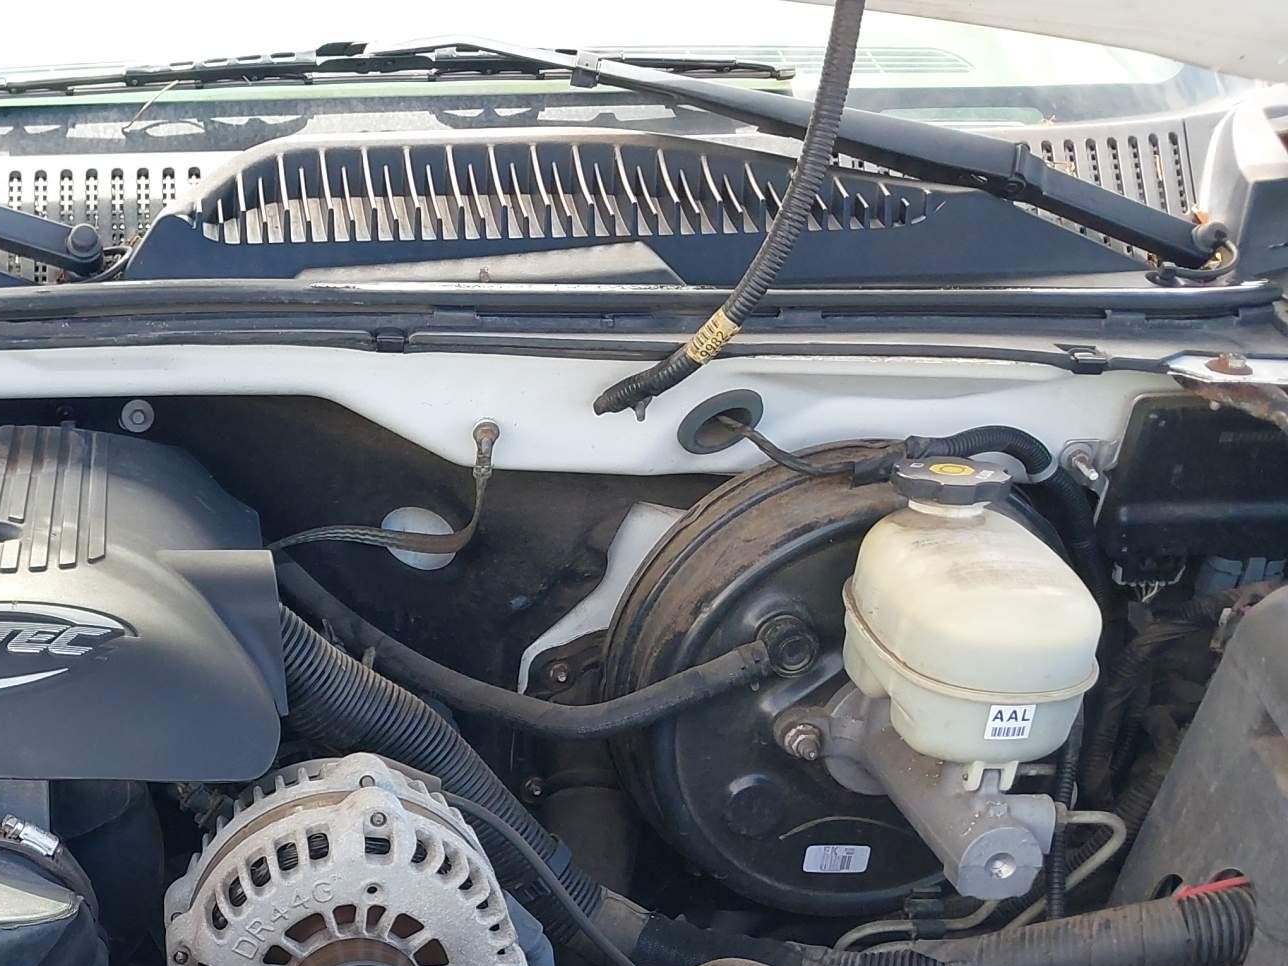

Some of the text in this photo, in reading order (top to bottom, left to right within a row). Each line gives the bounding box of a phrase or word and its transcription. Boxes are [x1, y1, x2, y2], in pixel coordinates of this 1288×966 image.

[700, 330, 728, 359] 9982
[991, 708, 1032, 722] AAL
[231, 881, 335, 960] DR44G
